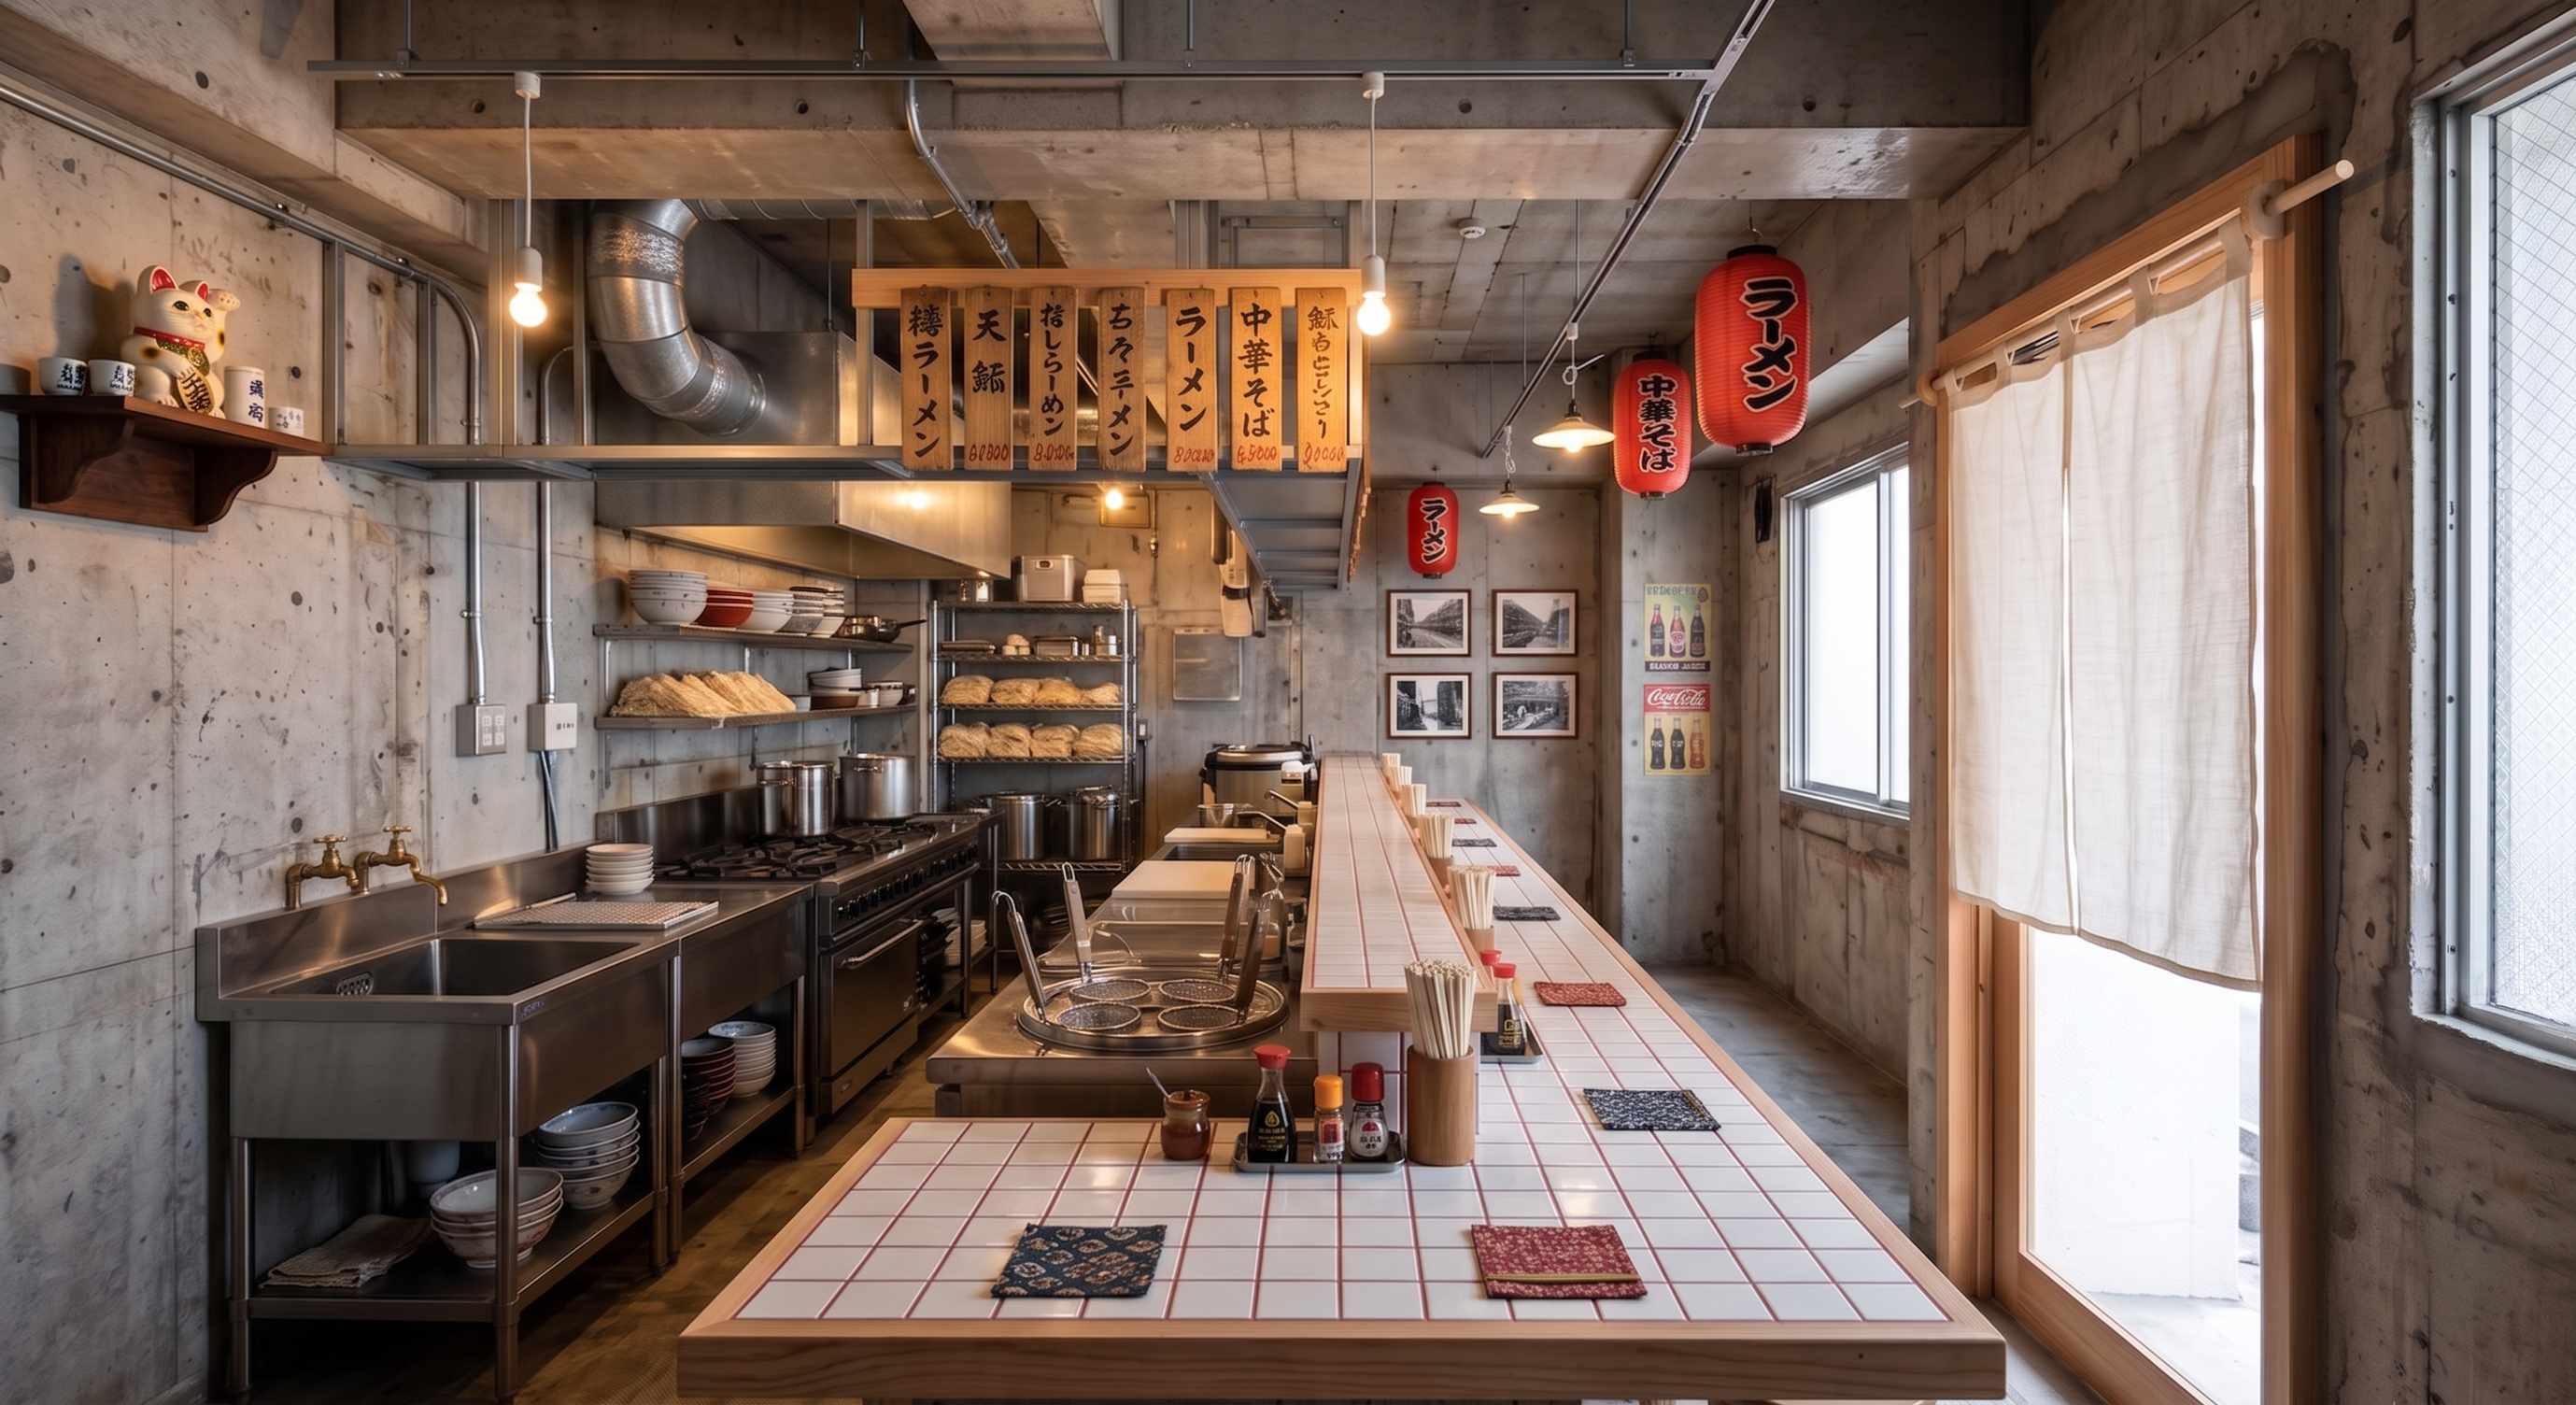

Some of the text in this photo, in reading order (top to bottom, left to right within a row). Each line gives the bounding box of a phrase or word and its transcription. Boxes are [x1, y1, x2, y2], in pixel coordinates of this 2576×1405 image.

[1175, 305, 1208, 432] ラーメン
[1237, 302, 1276, 438] 中華そば
[1739, 276, 1799, 412] ラーメン
[1635, 373, 1678, 473] 中華そば
[1420, 497, 1449, 564] ラーメン
